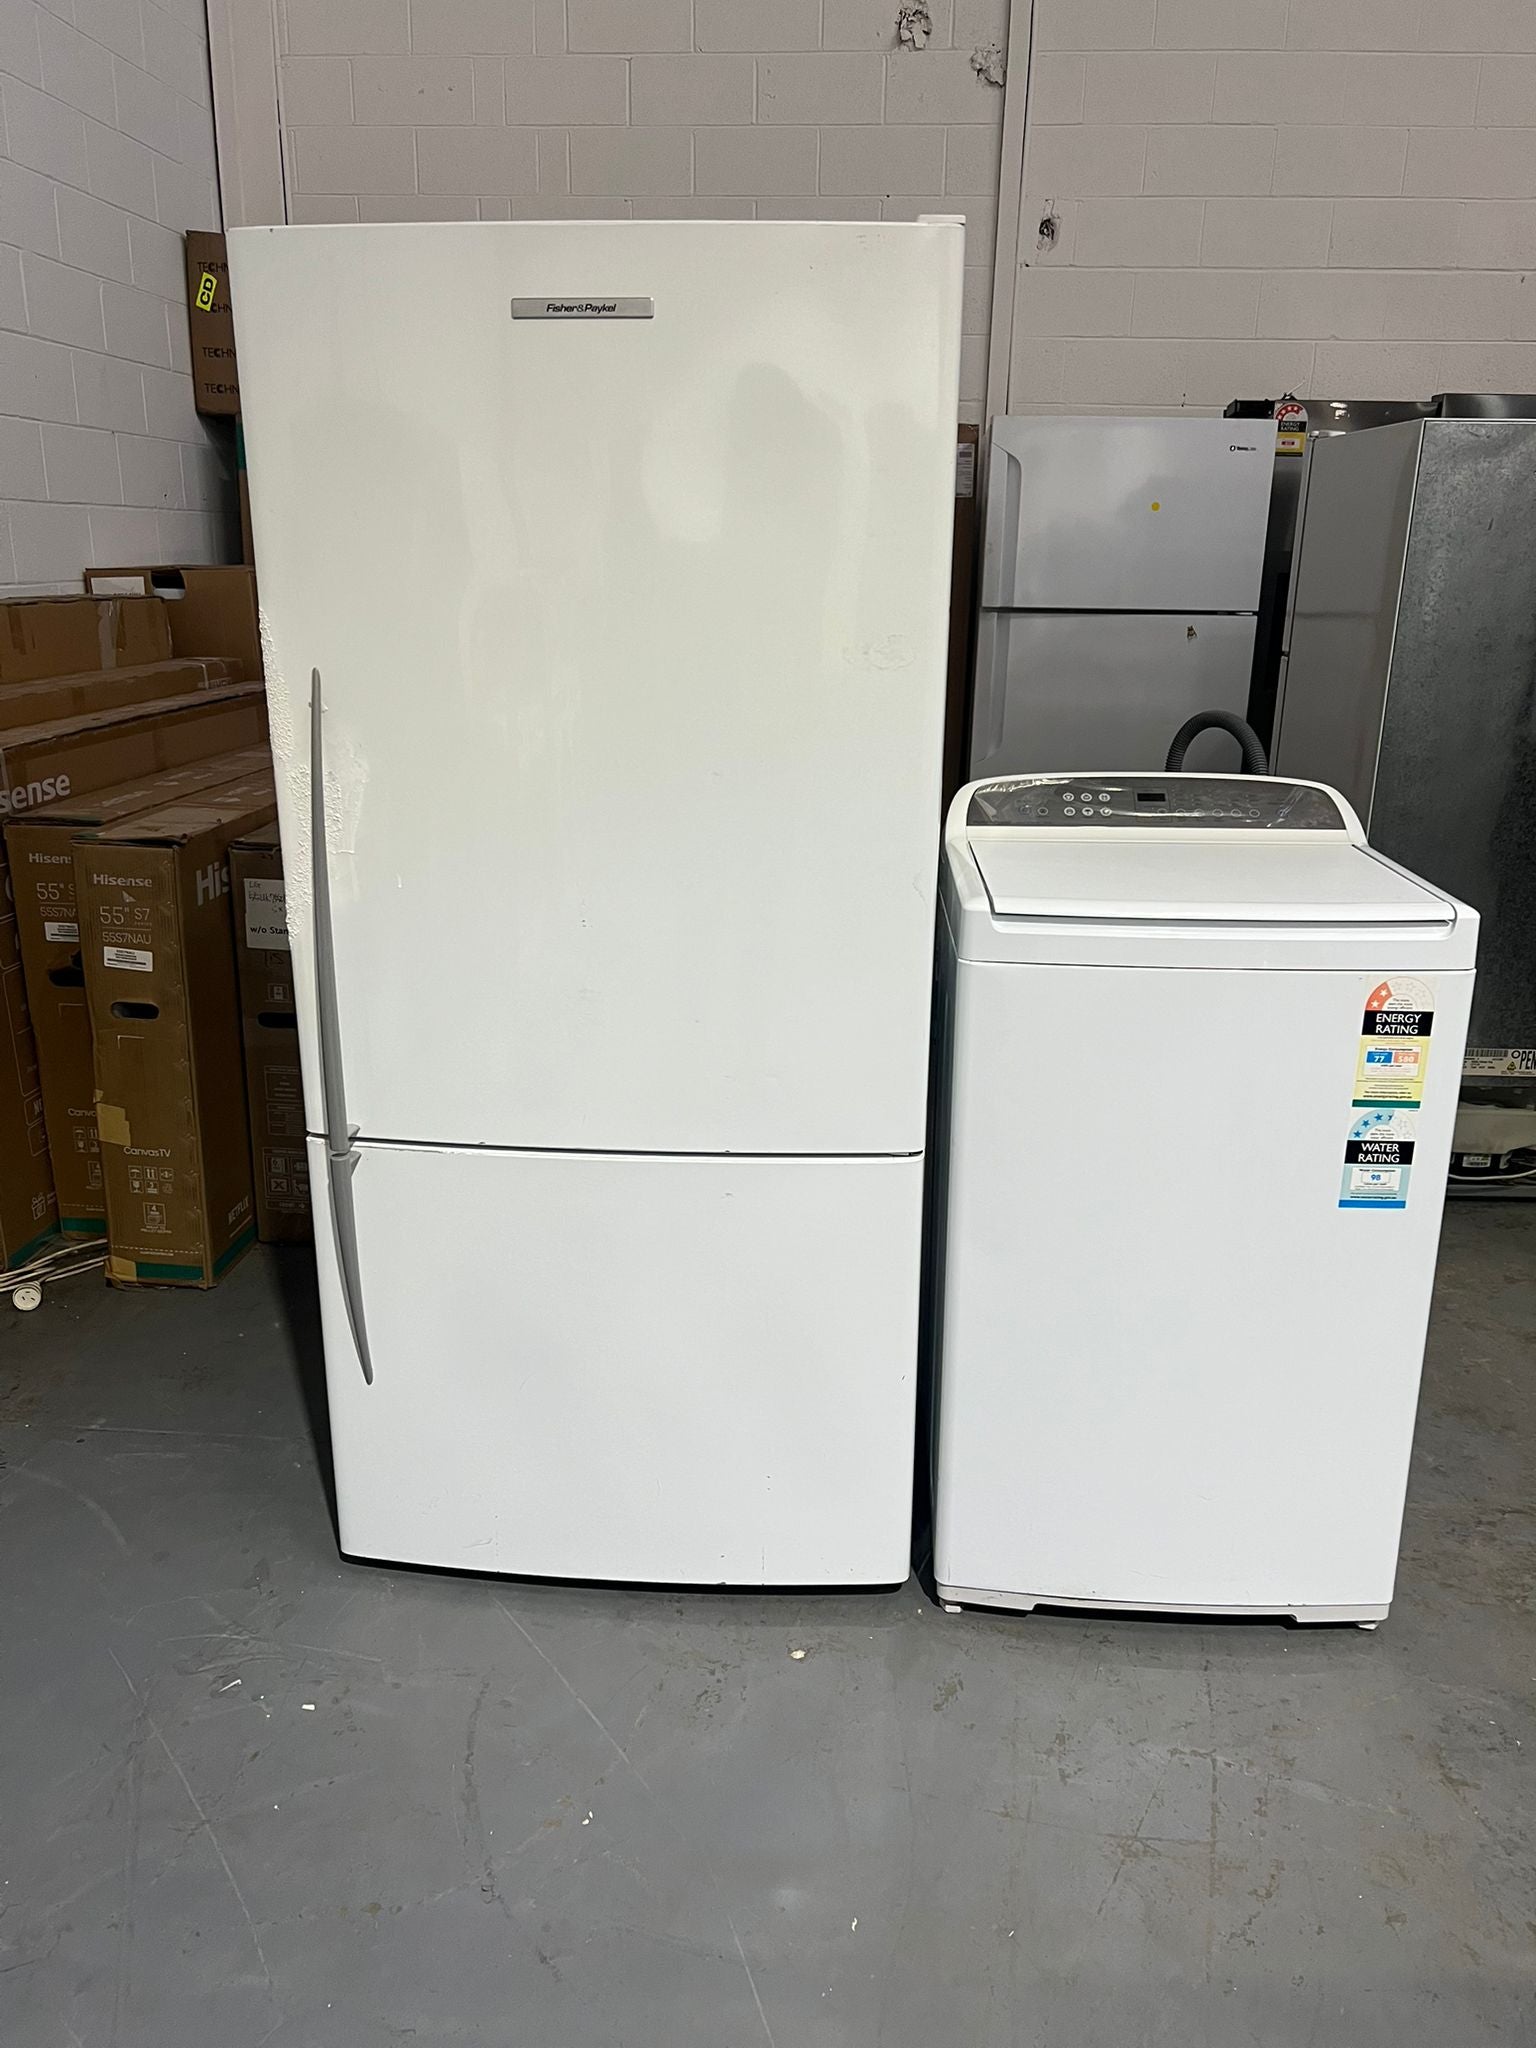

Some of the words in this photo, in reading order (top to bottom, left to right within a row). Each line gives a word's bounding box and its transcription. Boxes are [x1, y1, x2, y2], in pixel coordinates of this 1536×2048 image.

[200, 278, 213, 305] CD
[93, 873, 153, 888] Hisense
[134, 907, 150, 921] S7
[250, 926, 267, 934] w/o
[102, 931, 152, 945] 55S7NAU
[1376, 1013, 1422, 1024] ENERGY
[1375, 1024, 1419, 1035] RATING
[1373, 1055, 1386, 1063] 77
[123, 1146, 171, 1158] CanvasTV
[1361, 1142, 1400, 1153] WATER
[1357, 1153, 1400, 1164] RATING
